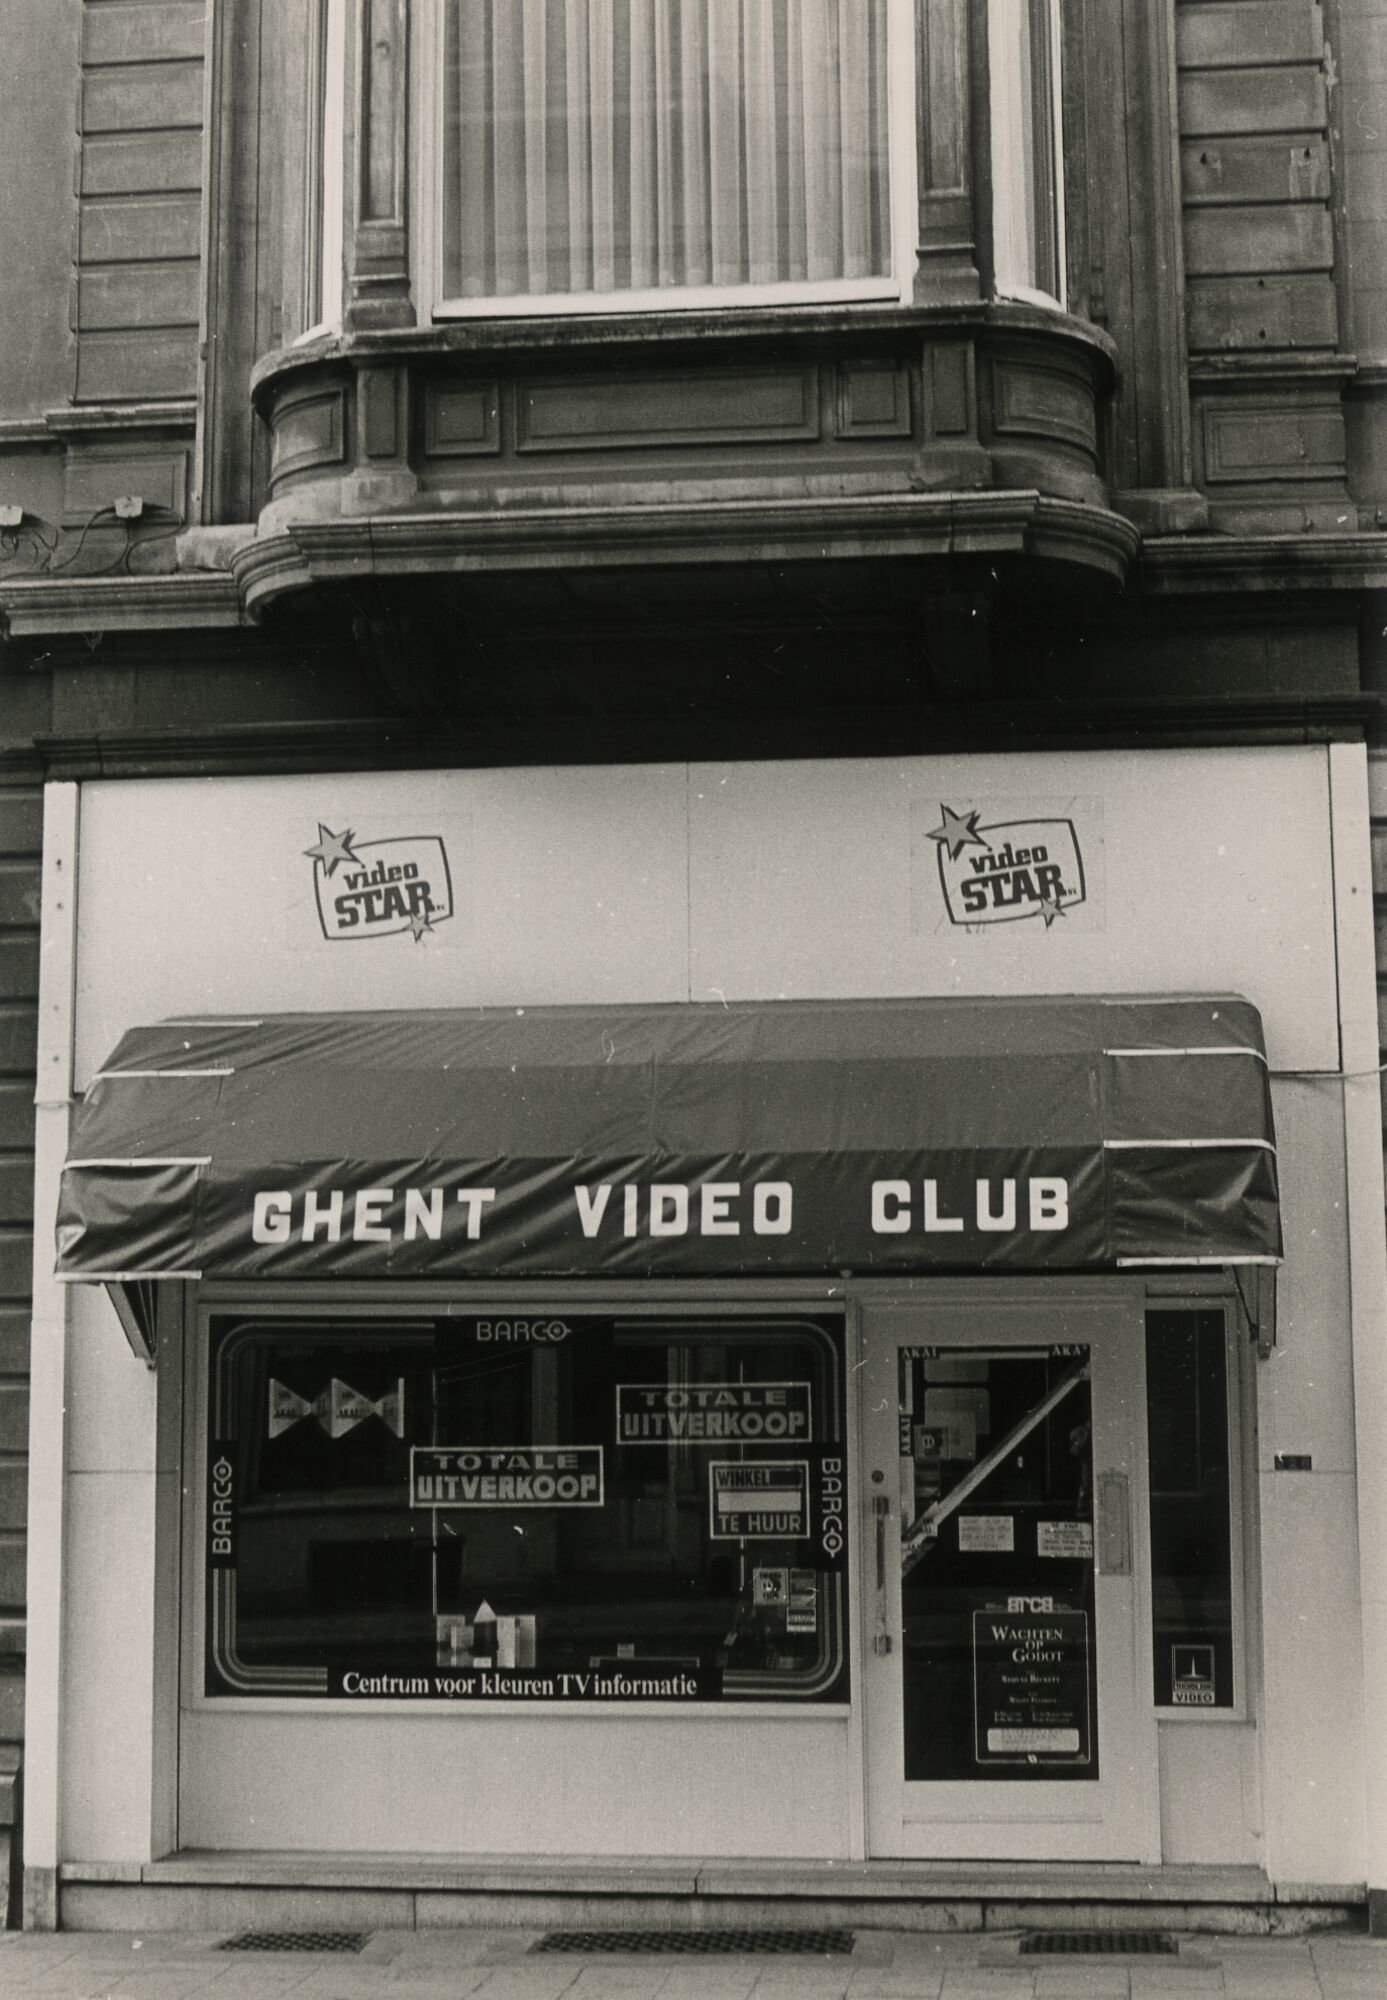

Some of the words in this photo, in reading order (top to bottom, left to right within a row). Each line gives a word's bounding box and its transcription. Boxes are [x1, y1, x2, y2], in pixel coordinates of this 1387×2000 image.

[969, 842, 1049, 874] video
[343, 860, 419, 891] video
[960, 864, 1067, 913] STAR
[334, 881, 436, 929] STAR
[252, 1187, 496, 1243] GHENT
[574, 1180, 793, 1238] VIDEO
[870, 1176, 1070, 1233] CLUB
[476, 1320, 572, 1342] BARCO
[903, 1347, 938, 1359] AKAI
[641, 1390, 787, 1407] TOTALE
[624, 1411, 805, 1436] UITVERKOOP
[433, 1453, 578, 1470] TOTALE
[417, 1475, 597, 1500] UITVERKOOP
[717, 1469, 770, 1488] WINKEL
[211, 1456, 233, 1555] BARCO
[821, 1458, 843, 1558] BARCO
[718, 1514, 740, 1532] TE
[748, 1513, 802, 1532] HUUR
[1007, 1596, 1054, 1614] arca
[342, 1671, 429, 1694] Centrum
[434, 1677, 476, 1694] voor
[481, 1673, 554, 1695] kleuren
[557, 1674, 590, 1695] TV
[594, 1673, 698, 1696] informatie
[1176, 1693, 1212, 1702] VIDEO
